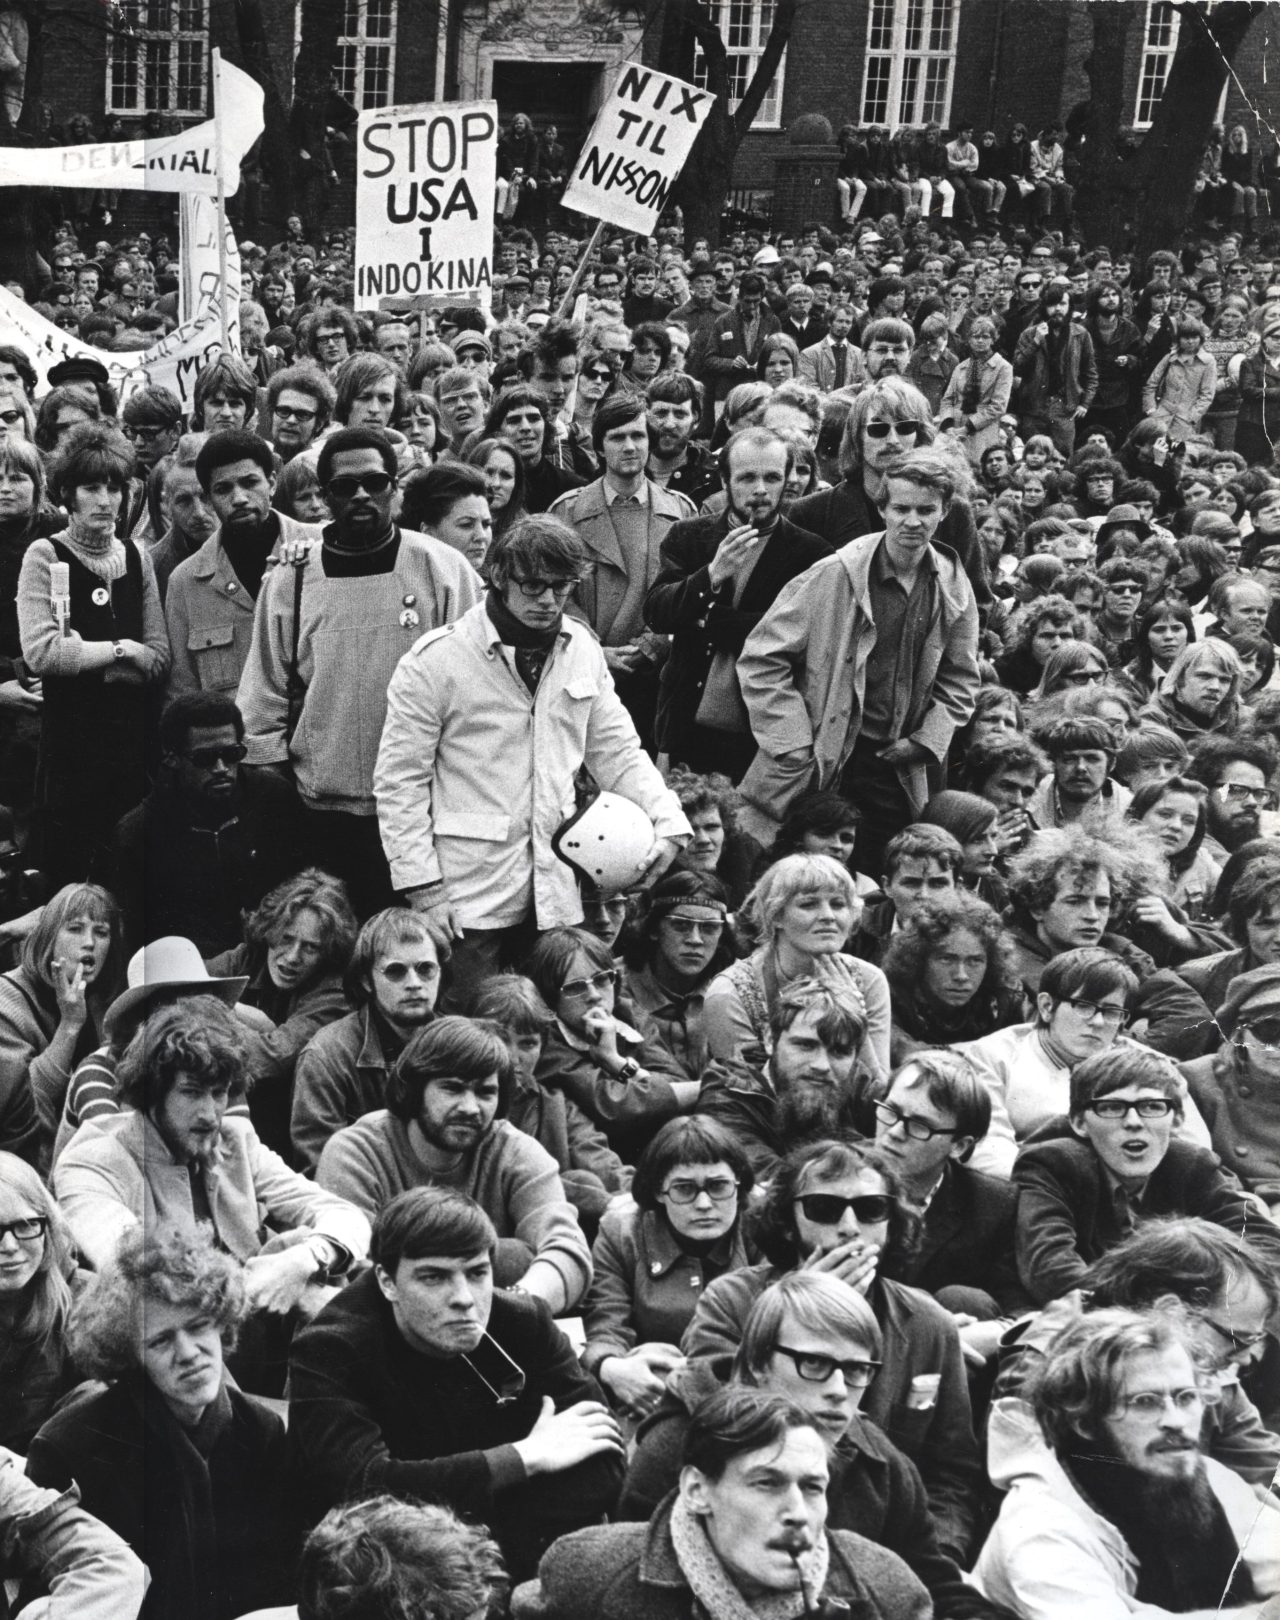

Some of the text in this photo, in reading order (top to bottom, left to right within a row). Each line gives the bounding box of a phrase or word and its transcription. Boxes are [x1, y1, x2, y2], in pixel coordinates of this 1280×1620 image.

[617, 67, 707, 123] NIX
[363, 112, 495, 178] STOP
[617, 109, 667, 156] TIL
[387, 177, 478, 224] USA
[419, 227, 432, 262] I
[358, 257, 492, 296] INDOKINA
